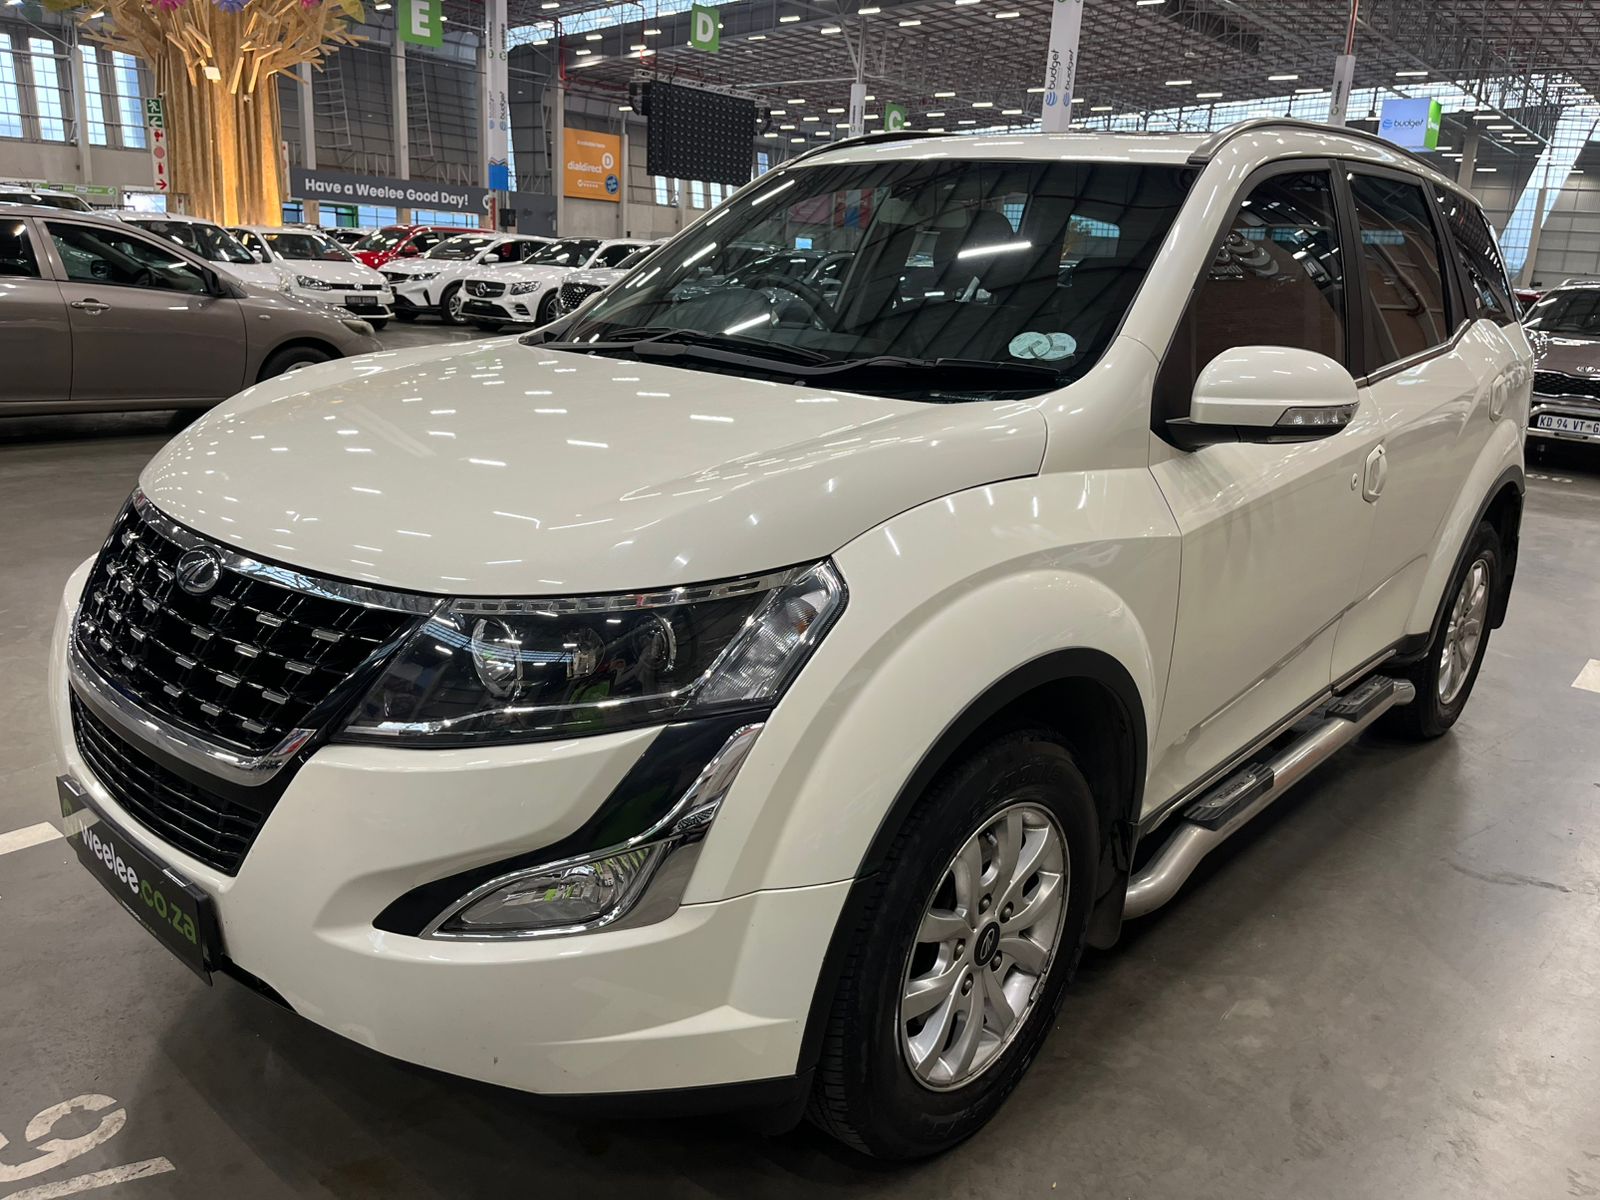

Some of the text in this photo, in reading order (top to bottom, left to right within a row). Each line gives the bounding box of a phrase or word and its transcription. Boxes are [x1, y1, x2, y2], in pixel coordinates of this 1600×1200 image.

[411, 0, 431, 37] E
[696, 11, 714, 42] D
[1048, 50, 1061, 90] budget
[1065, 48, 1074, 91] budget
[888, 110, 902, 131] C
[1393, 117, 1424, 129] budget
[567, 160, 602, 174] dialdirect
[304, 178, 469, 208] Have a Weelee Good Day!
[1539, 415, 1553, 429] KD
[1556, 419, 1568, 430] 94
[1573, 420, 1586, 432] VT
